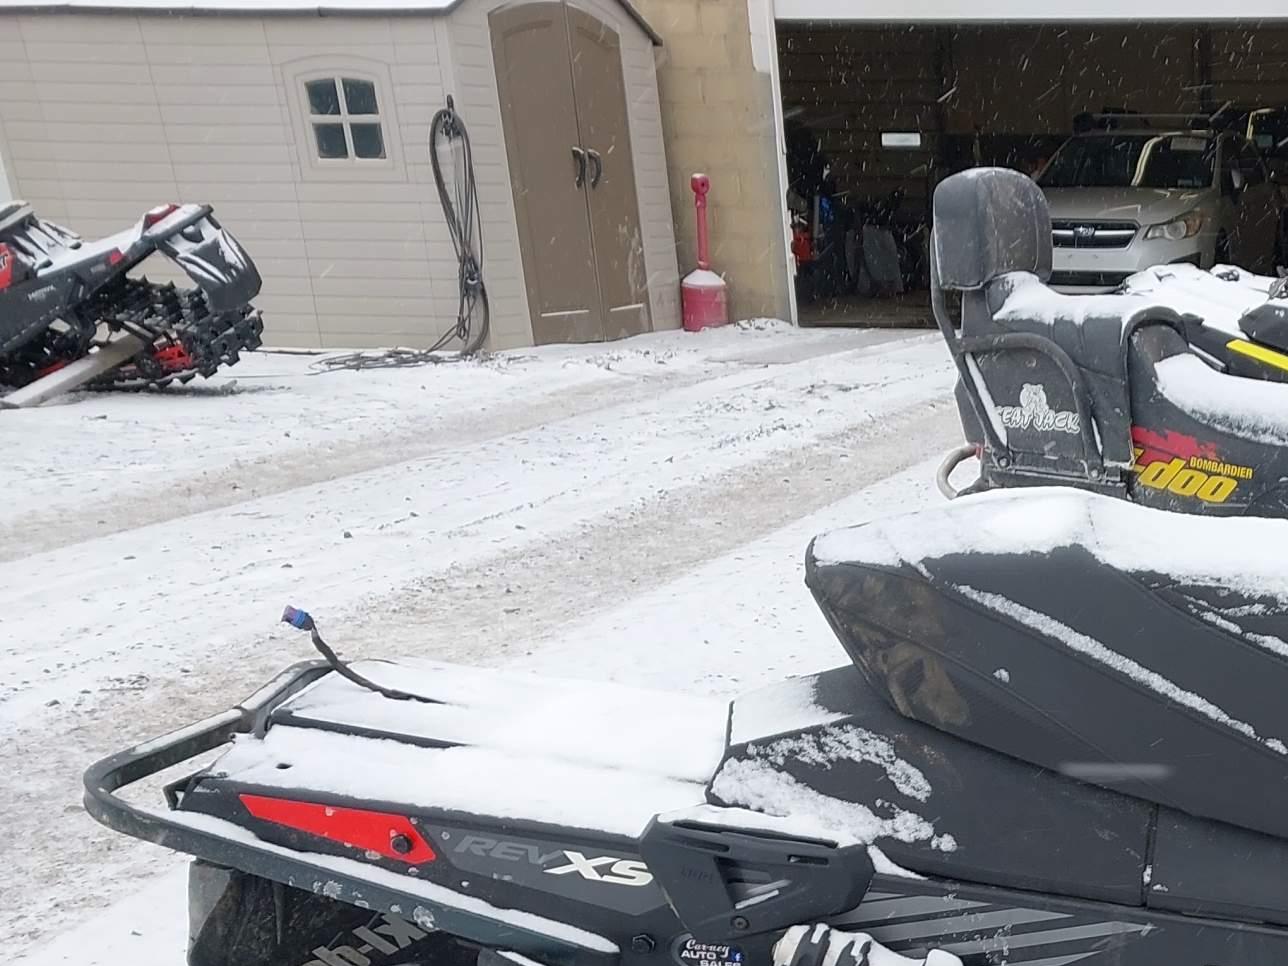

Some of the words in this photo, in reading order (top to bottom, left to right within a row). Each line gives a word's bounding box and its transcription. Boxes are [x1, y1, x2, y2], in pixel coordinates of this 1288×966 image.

[994, 405, 1034, 431] EAT
[1189, 456, 1254, 479] BOMBARDIER
[454, 835, 565, 865] REV
[543, 849, 654, 887] XS
[681, 949, 717, 960] AUTO
